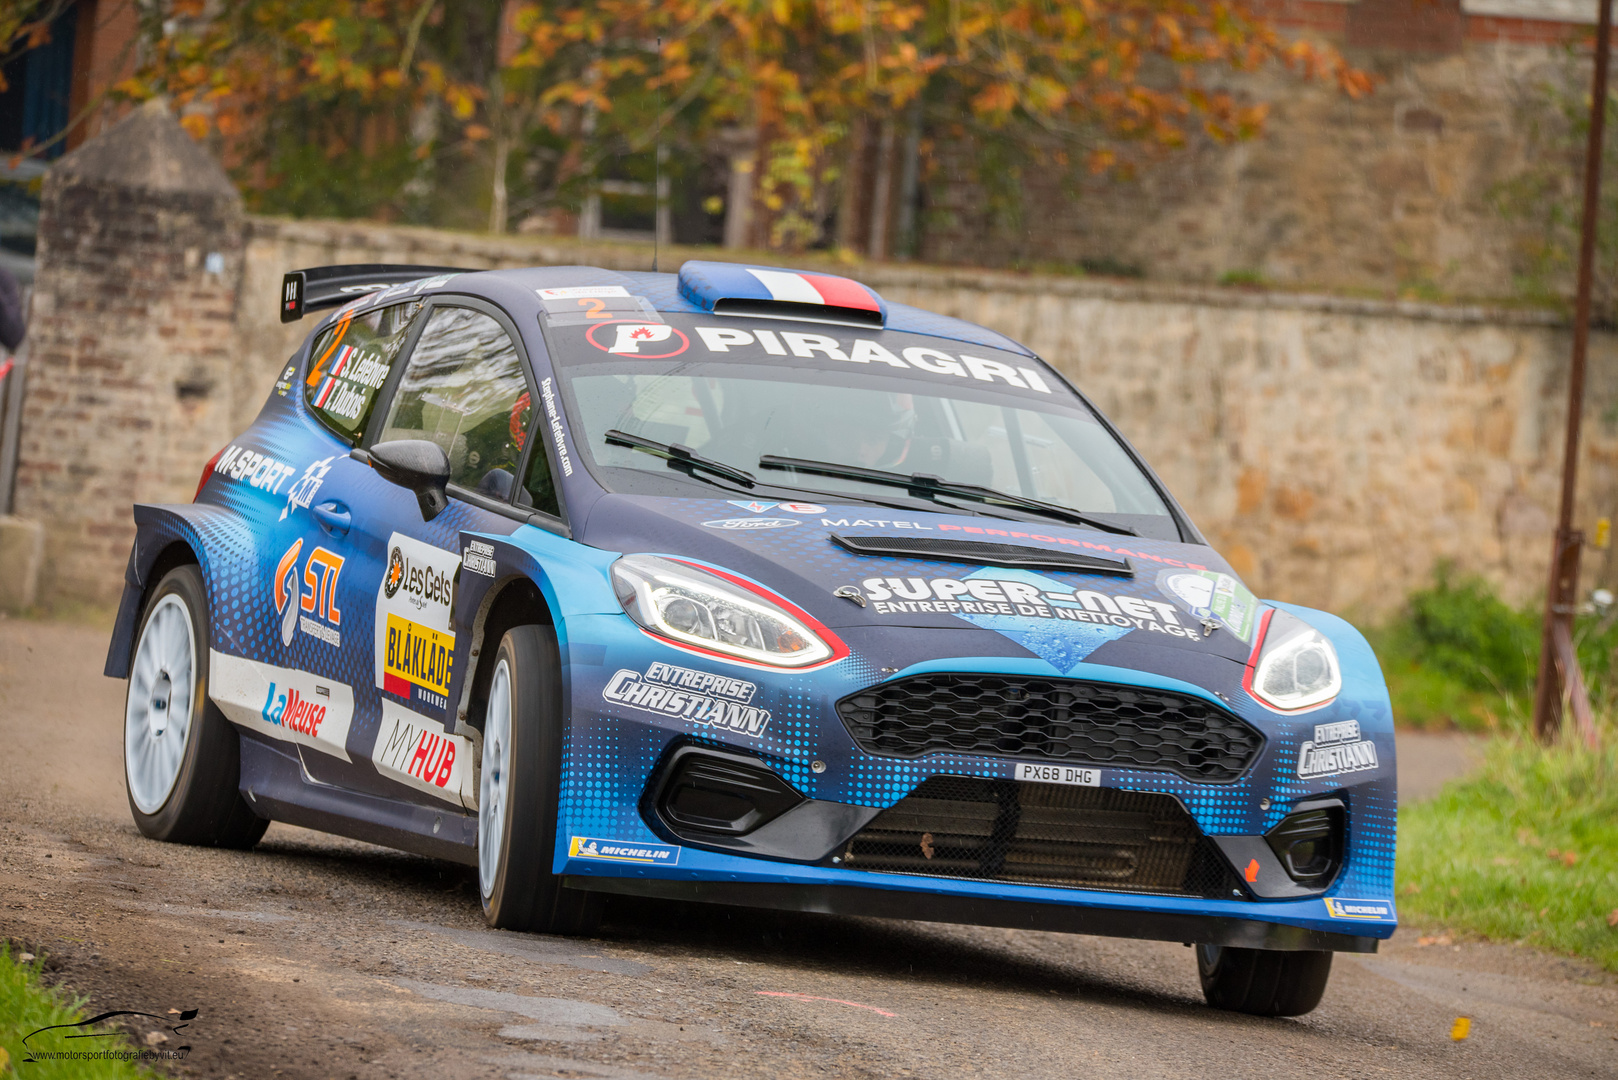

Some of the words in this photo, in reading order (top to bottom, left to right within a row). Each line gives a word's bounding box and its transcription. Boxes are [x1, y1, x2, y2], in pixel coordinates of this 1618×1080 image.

[578, 297, 613, 319] 2
[306, 309, 354, 387] 2
[695, 327, 1052, 394] PIRAGRI
[348, 350, 390, 389] Lefebvre
[330, 381, 366, 419] Dubois
[541, 377, 573, 477] Stephane-Lefebvre.com
[214, 445, 296, 495] M-SPORT
[722, 519, 782, 528] Ford
[820, 518, 933, 531] MATEL
[937, 524, 1207, 571] PERFORMANCE
[301, 546, 345, 626] STL
[873, 601, 1014, 616] ENTREPRISE
[1016, 602, 1052, 617] DE
[1059, 609, 1201, 642] NETTOYAGE
[646, 662, 754, 701] ENTREPRISE
[603, 669, 770, 737] CHRISTIANN
[1024, 765, 1060, 781] PX68
[1065, 769, 1092, 783] DHG
[1297, 740, 1379, 779] CHRISTIANN
[600, 846, 670, 859] MICHELIN
[1344, 905, 1388, 915] MICHELIN
